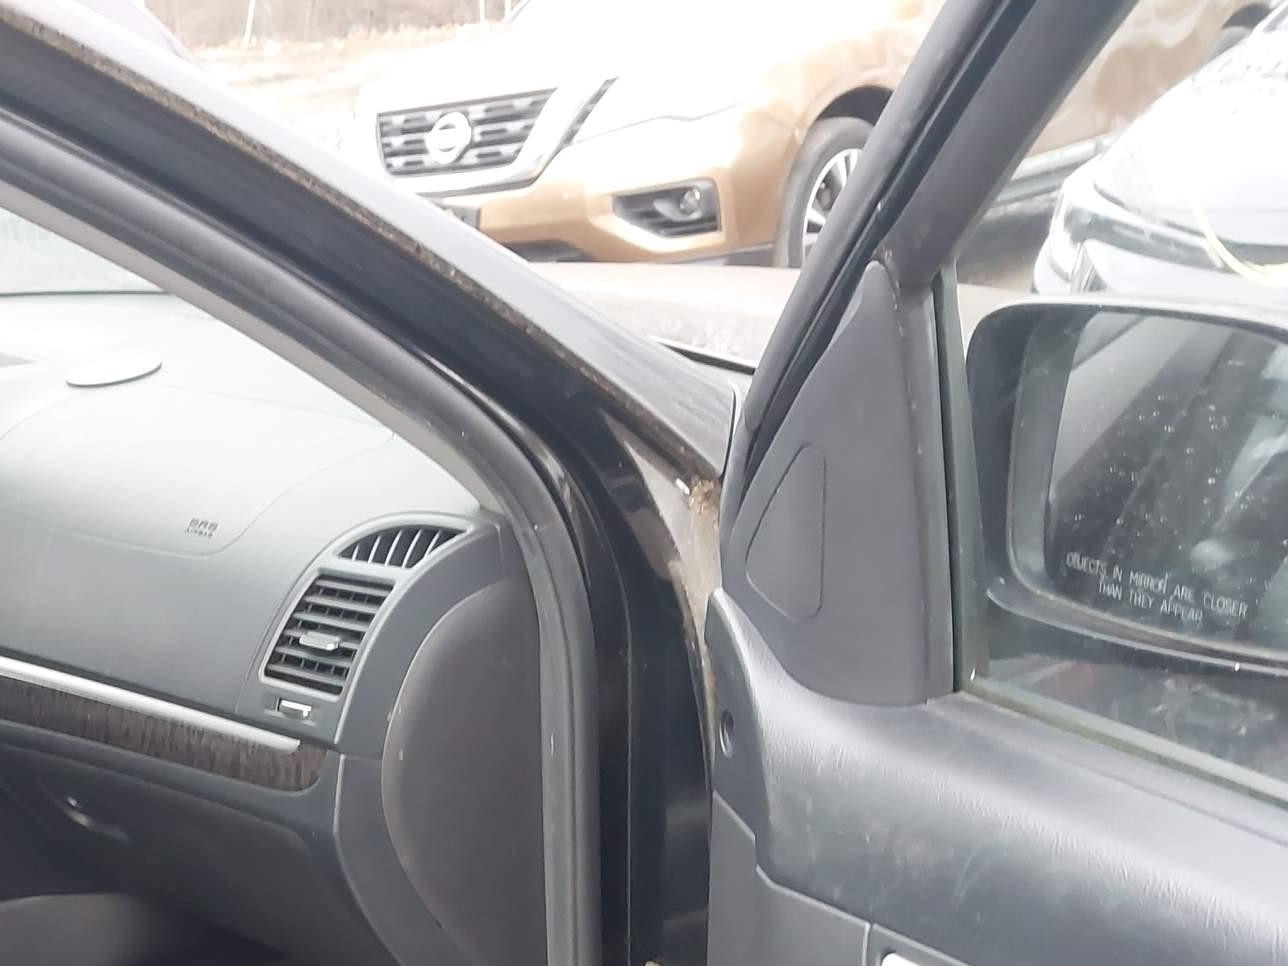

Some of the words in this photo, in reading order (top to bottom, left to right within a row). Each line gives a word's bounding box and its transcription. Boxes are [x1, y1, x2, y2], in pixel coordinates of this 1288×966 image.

[1065, 551, 1107, 577] OBJECTS
[1112, 566, 1123, 581] IN
[1173, 584, 1195, 602] ARE
[1203, 592, 1249, 617] CLOSER
[1098, 579, 1123, 601] THAN
[1129, 591, 1154, 609] THEY
